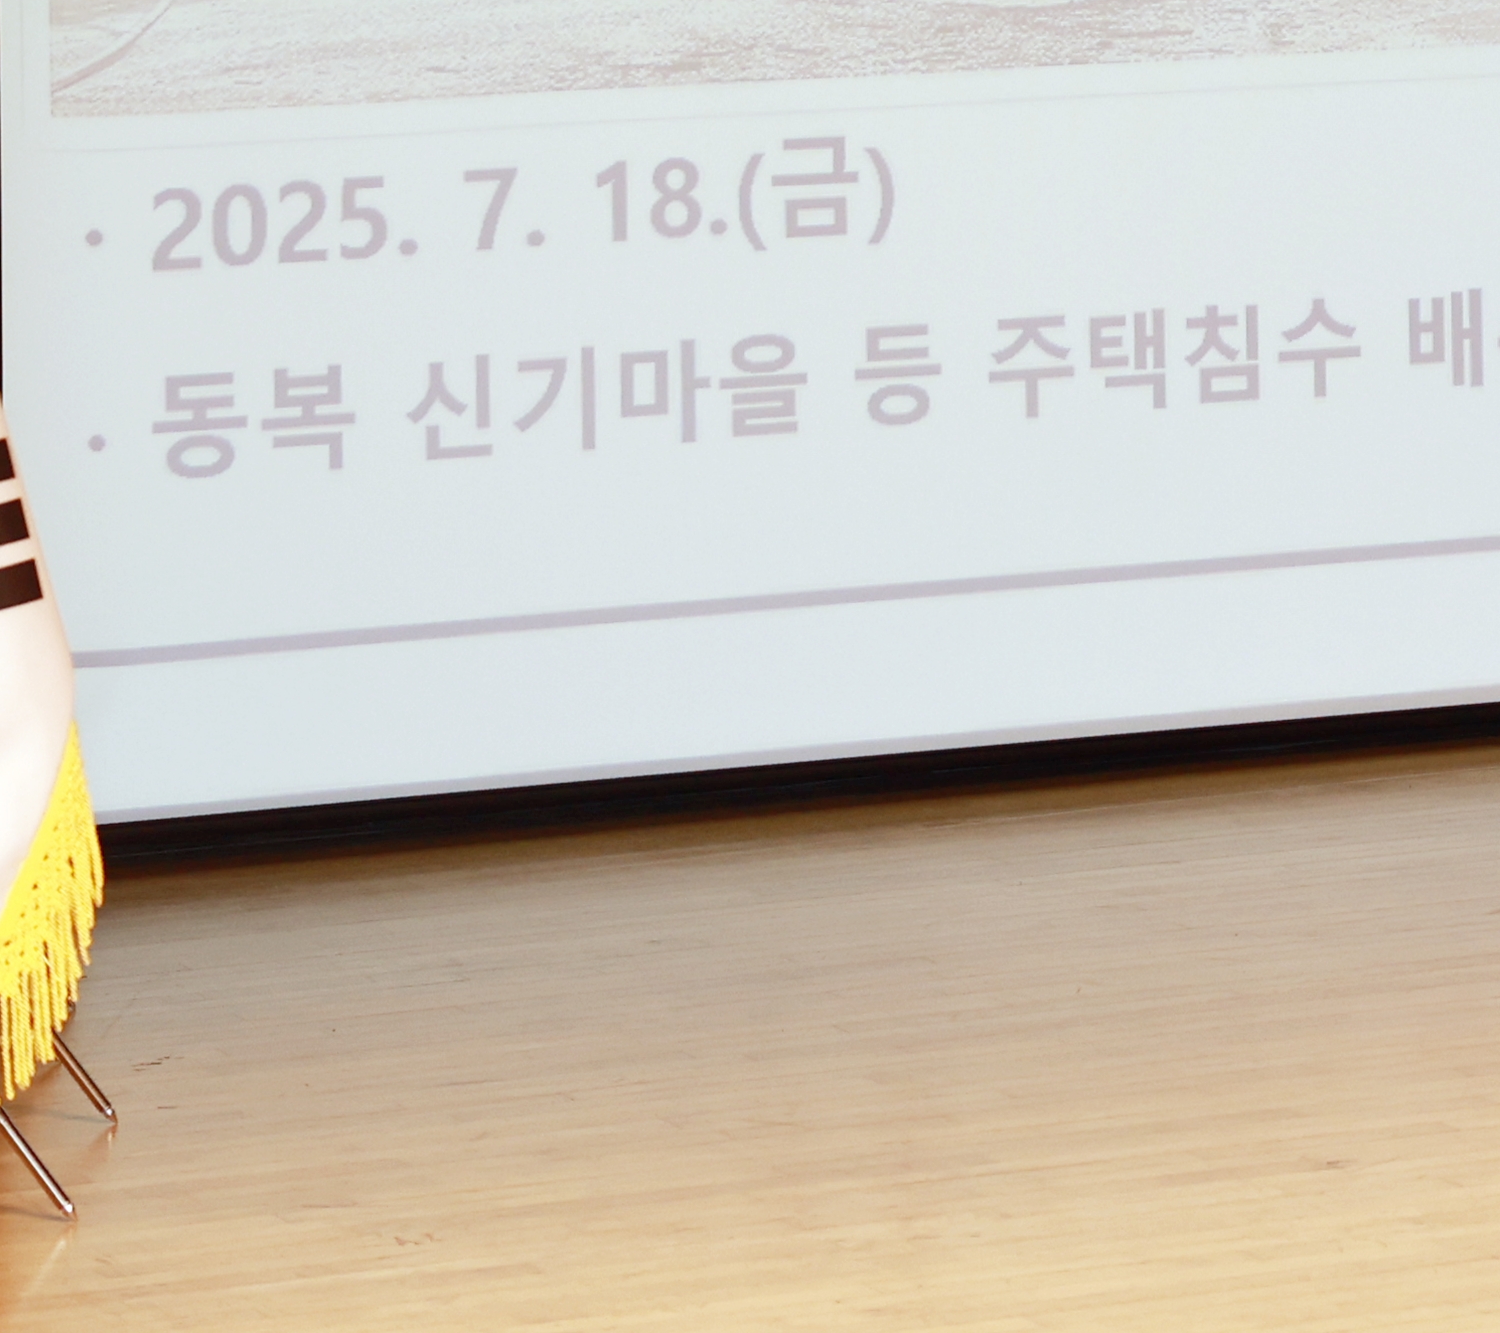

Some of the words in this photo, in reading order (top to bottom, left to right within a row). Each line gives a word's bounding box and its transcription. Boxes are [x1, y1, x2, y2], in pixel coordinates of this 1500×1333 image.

[151, 176, 419, 273] 2025.
[463, 167, 546, 251] 7.
[595, 135, 895, 252] 18.(금)
[151, 364, 356, 479] 동복
[406, 333, 808, 461] 신기마을
[854, 323, 942, 427] 등
[988, 297, 1362, 419] 주택침수
